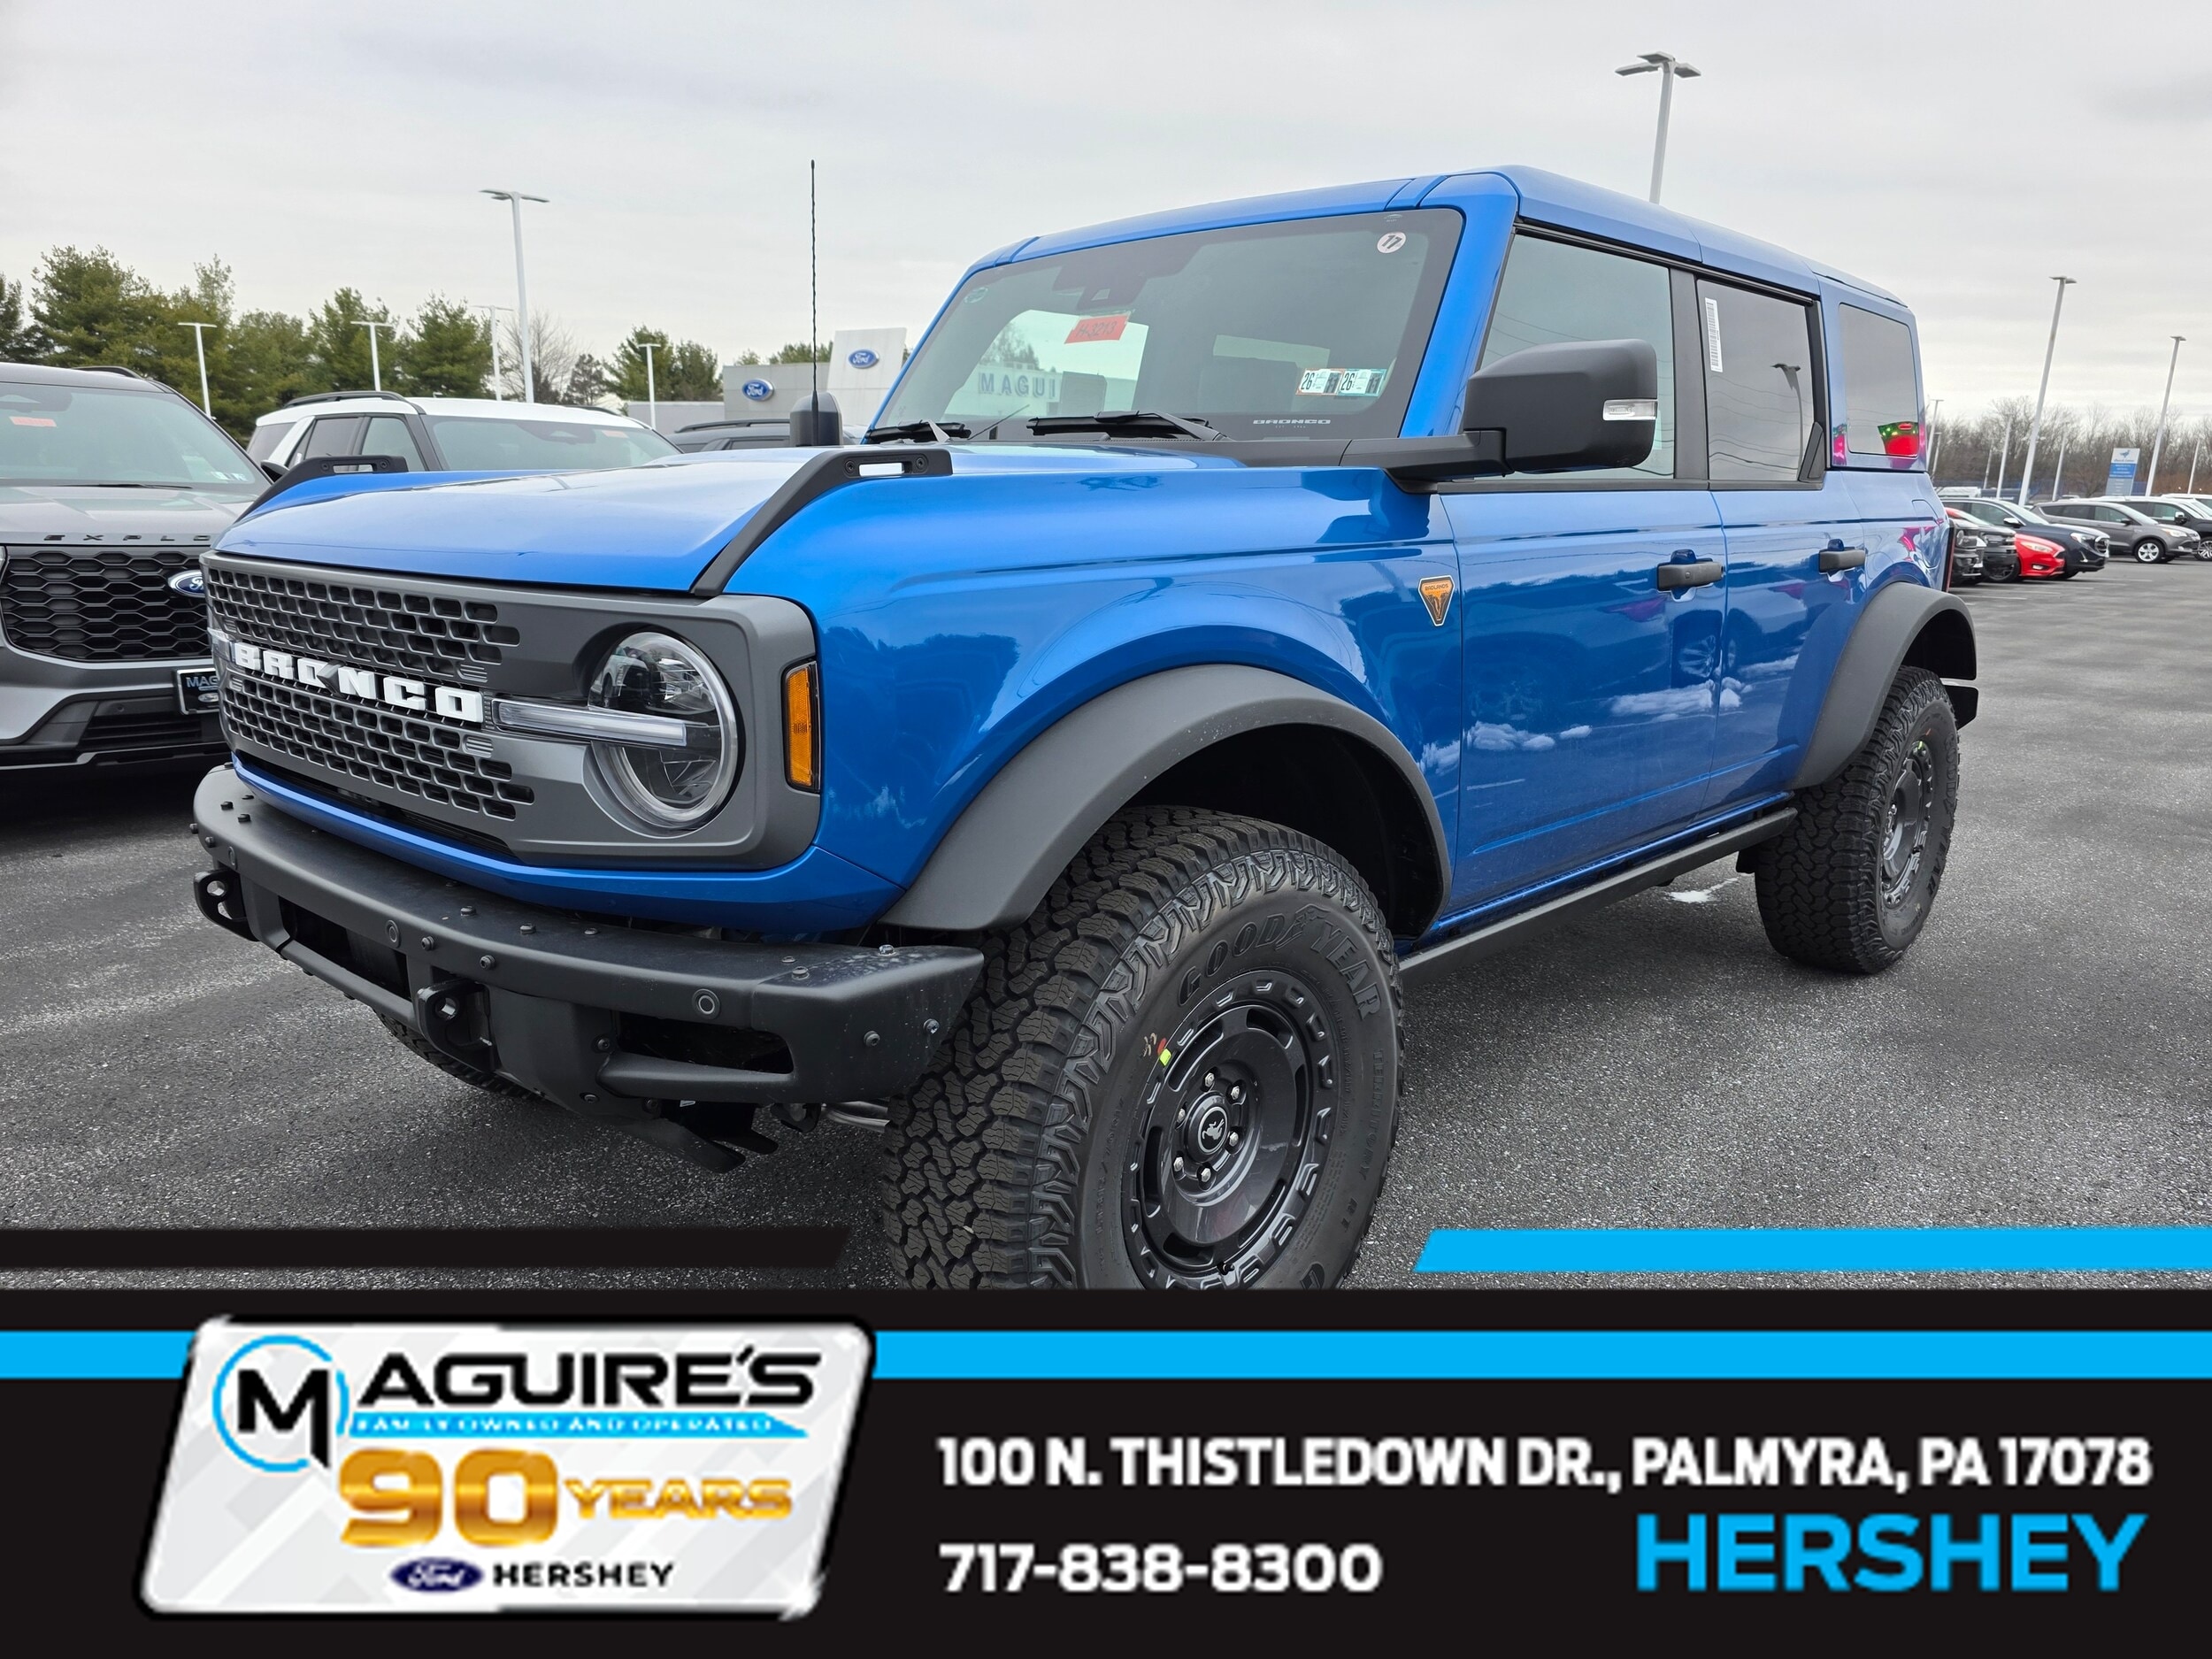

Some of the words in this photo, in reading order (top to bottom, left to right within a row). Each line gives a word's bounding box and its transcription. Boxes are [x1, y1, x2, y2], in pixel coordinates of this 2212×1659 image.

[1381, 234, 1403, 250] 17
[1301, 372, 1315, 390] 26
[1340, 373, 1356, 391] 26
[234, 641, 485, 724] BRONCO
